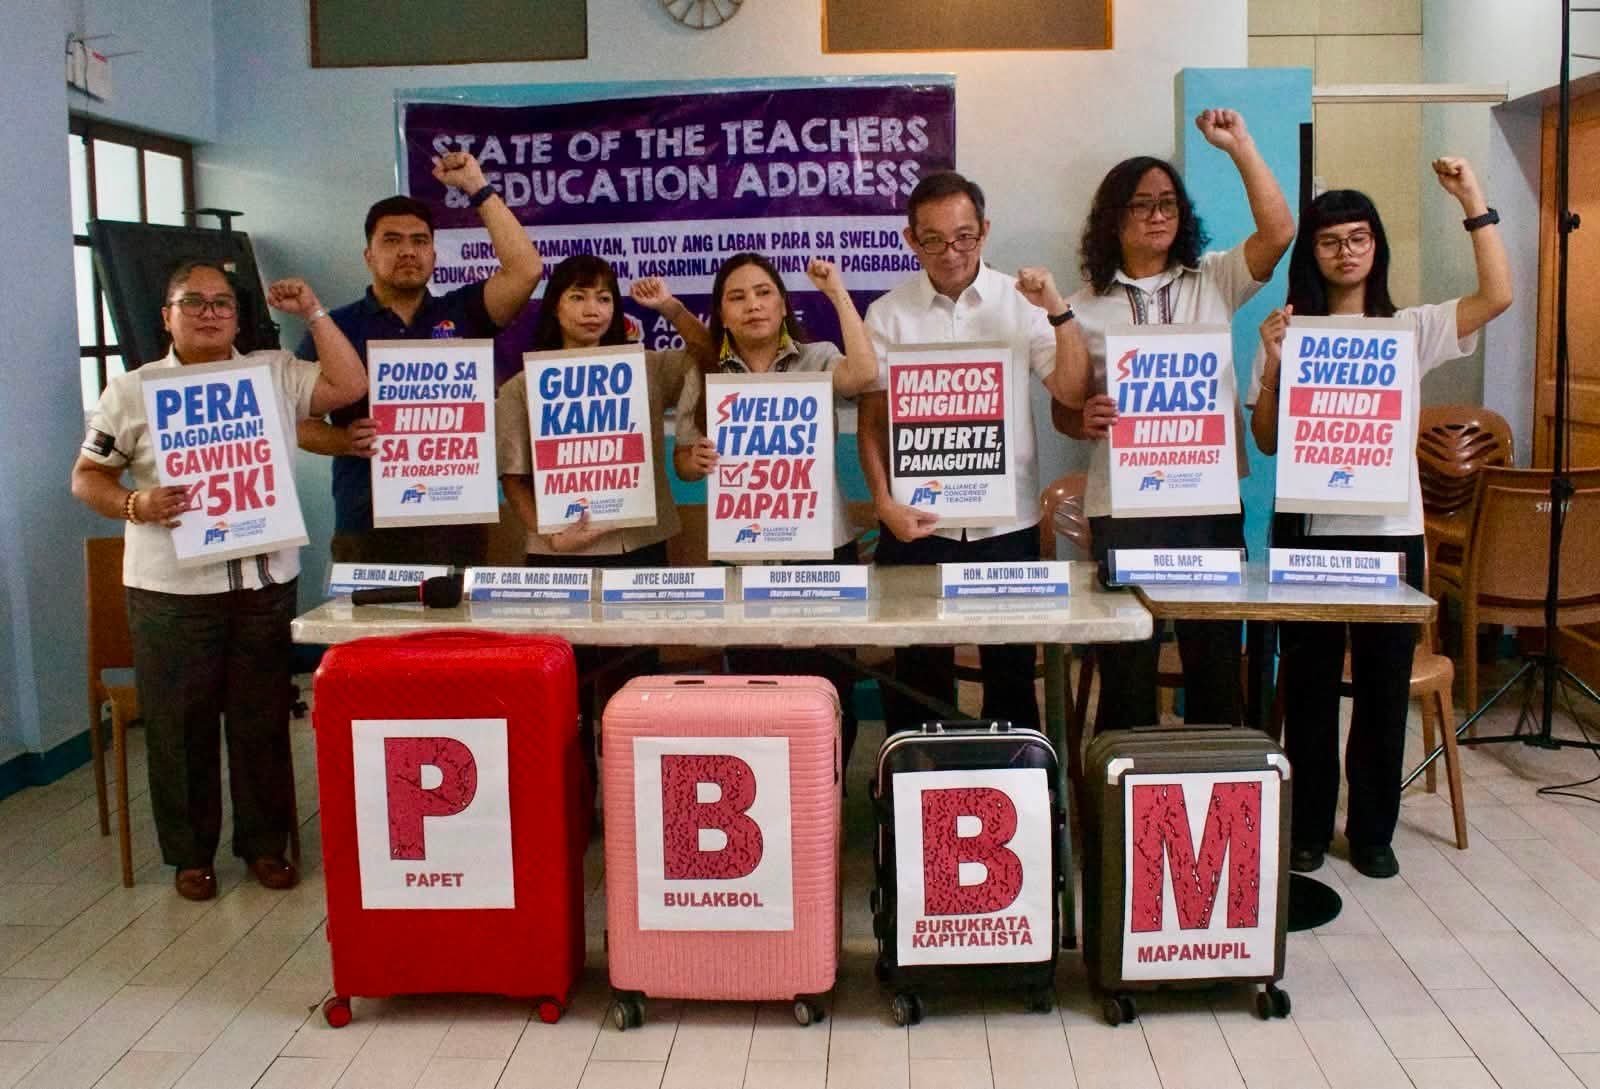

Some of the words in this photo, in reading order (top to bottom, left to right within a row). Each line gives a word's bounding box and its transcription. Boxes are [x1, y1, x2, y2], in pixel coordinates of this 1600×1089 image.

[432, 133, 553, 165] STATE
[567, 131, 621, 162] OF
[636, 124, 705, 160] THE
[721, 116, 929, 155] TEACHERS
[733, 159, 921, 198] ADDRESS
[631, 236, 677, 254] TULOY
[682, 232, 713, 253] ANG
[718, 231, 766, 252] LABAN
[771, 231, 811, 250] PARA
[815, 230, 836, 249] SA
[840, 230, 903, 250] SWELDO,
[433, 265, 500, 284] EDUKASY
[638, 257, 727, 279] KASARINLA
[841, 254, 923, 273] PAGBABAG
[1299, 336, 1397, 360] DAGDAG
[378, 363, 448, 382] PONDO
[454, 361, 478, 381] SA
[1115, 348, 1218, 382] SWELDO
[1298, 361, 1396, 386] SWELDO
[378, 383, 478, 403] EDUKASYON,
[539, 362, 632, 400] GURO
[897, 367, 999, 394] MARCOS,
[156, 378, 261, 430] PERA
[716, 392, 818, 425] SWELDO
[897, 393, 998, 417] SINGILIN!
[1118, 380, 1218, 413] ITAAS!
[1310, 391, 1382, 416] HINDI
[393, 407, 463, 432] HINDI
[540, 397, 635, 437] KAMI,
[160, 418, 265, 451] DAGDAGAN!
[716, 423, 818, 456] ITAAS!
[898, 426, 1002, 452] DUTERTE,
[1133, 418, 1203, 445] HINDI
[1294, 420, 1393, 445] DAGDAG
[165, 439, 272, 477] GAWING
[380, 438, 411, 462] SA
[418, 437, 479, 461] GERA
[557, 437, 623, 466] HINDI
[899, 452, 1001, 472] PANAGUTIN!
[1119, 449, 1220, 467] PANDARAHAS!
[1294, 445, 1393, 467] TRABAHO!
[382, 465, 399, 478] AT
[401, 462, 480, 478] KORAPSYON!
[544, 466, 640, 495] MAKINA!
[747, 459, 816, 490] 50K
[206, 464, 276, 517] 5K!
[716, 491, 818, 520] DAPAT!
[963, 568, 984, 580] HON.
[987, 567, 1024, 580] ANTONIO
[1027, 567, 1049, 579] TINIO
[1154, 555, 1175, 567] ROEL
[1178, 555, 1203, 567] MAPE
[1288, 555, 1328, 568] KRYSTAL
[475, 572, 499, 584] PROF.
[501, 572, 522, 584] CARL
[524, 572, 550, 585] MARC
[552, 573, 588, 585] RAMOTA
[632, 573, 659, 585] JOYCE
[662, 572, 695, 584] CAUBAT
[770, 571, 793, 583] RUBY
[795, 571, 840, 583] BERNARDO
[384, 737, 478, 861] P
[660, 754, 763, 881] B
[920, 786, 1024, 916] B
[1130, 781, 1262, 933] M
[405, 872, 464, 888] PAPET
[663, 892, 764, 908] BULAKBOL
[915, 915, 1031, 934] BURUKRATA
[912, 930, 1034, 949] KAPITALISTA
[1136, 942, 1251, 964] MAPANUPIL
